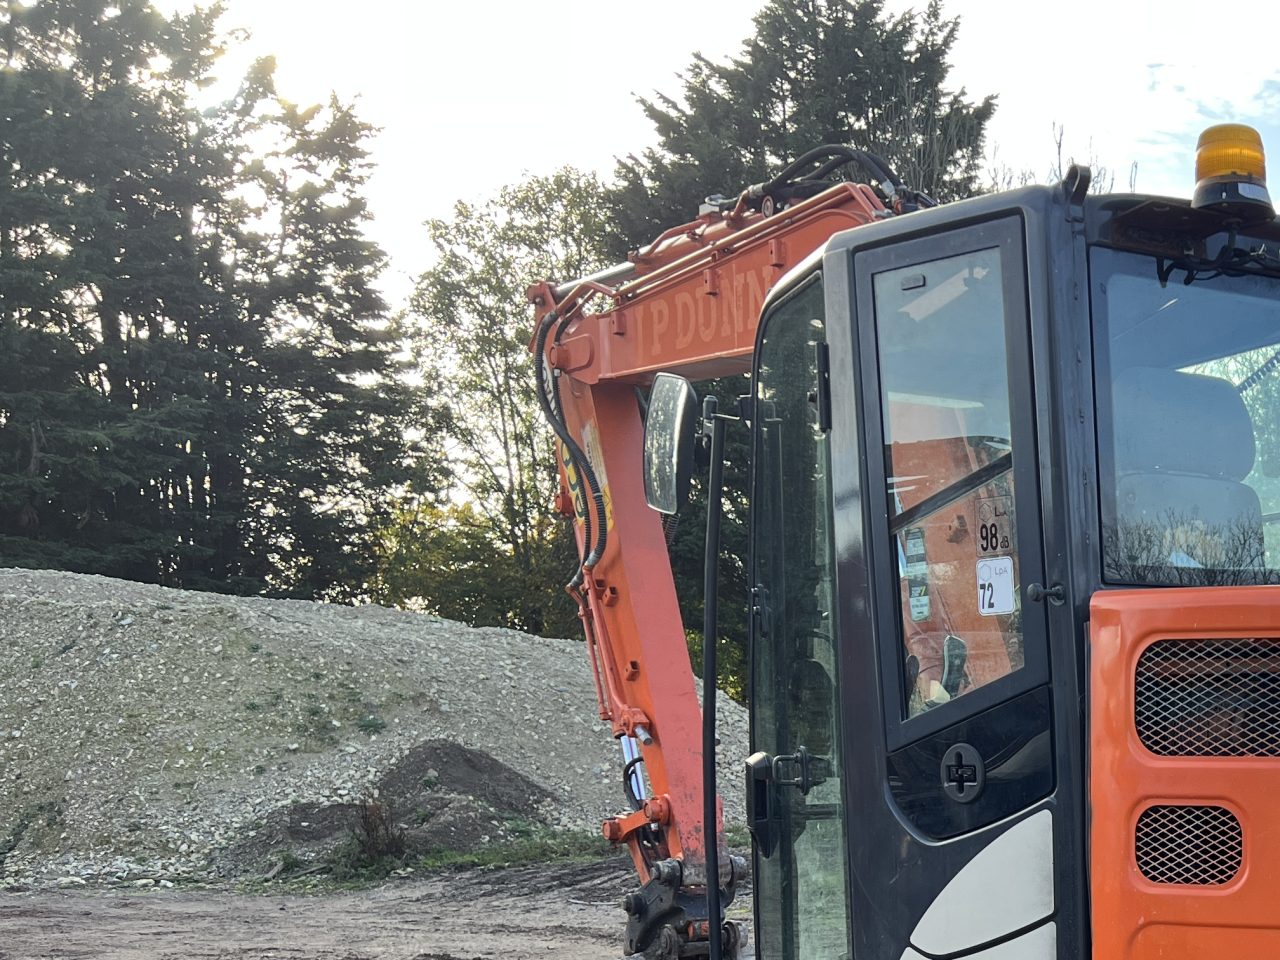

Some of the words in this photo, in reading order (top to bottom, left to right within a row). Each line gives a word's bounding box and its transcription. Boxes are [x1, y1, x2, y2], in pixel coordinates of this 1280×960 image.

[980, 523, 999, 552] 98
[1000, 535, 1010, 549] dB
[994, 566, 1009, 576] LpA
[979, 582, 995, 610] 72
